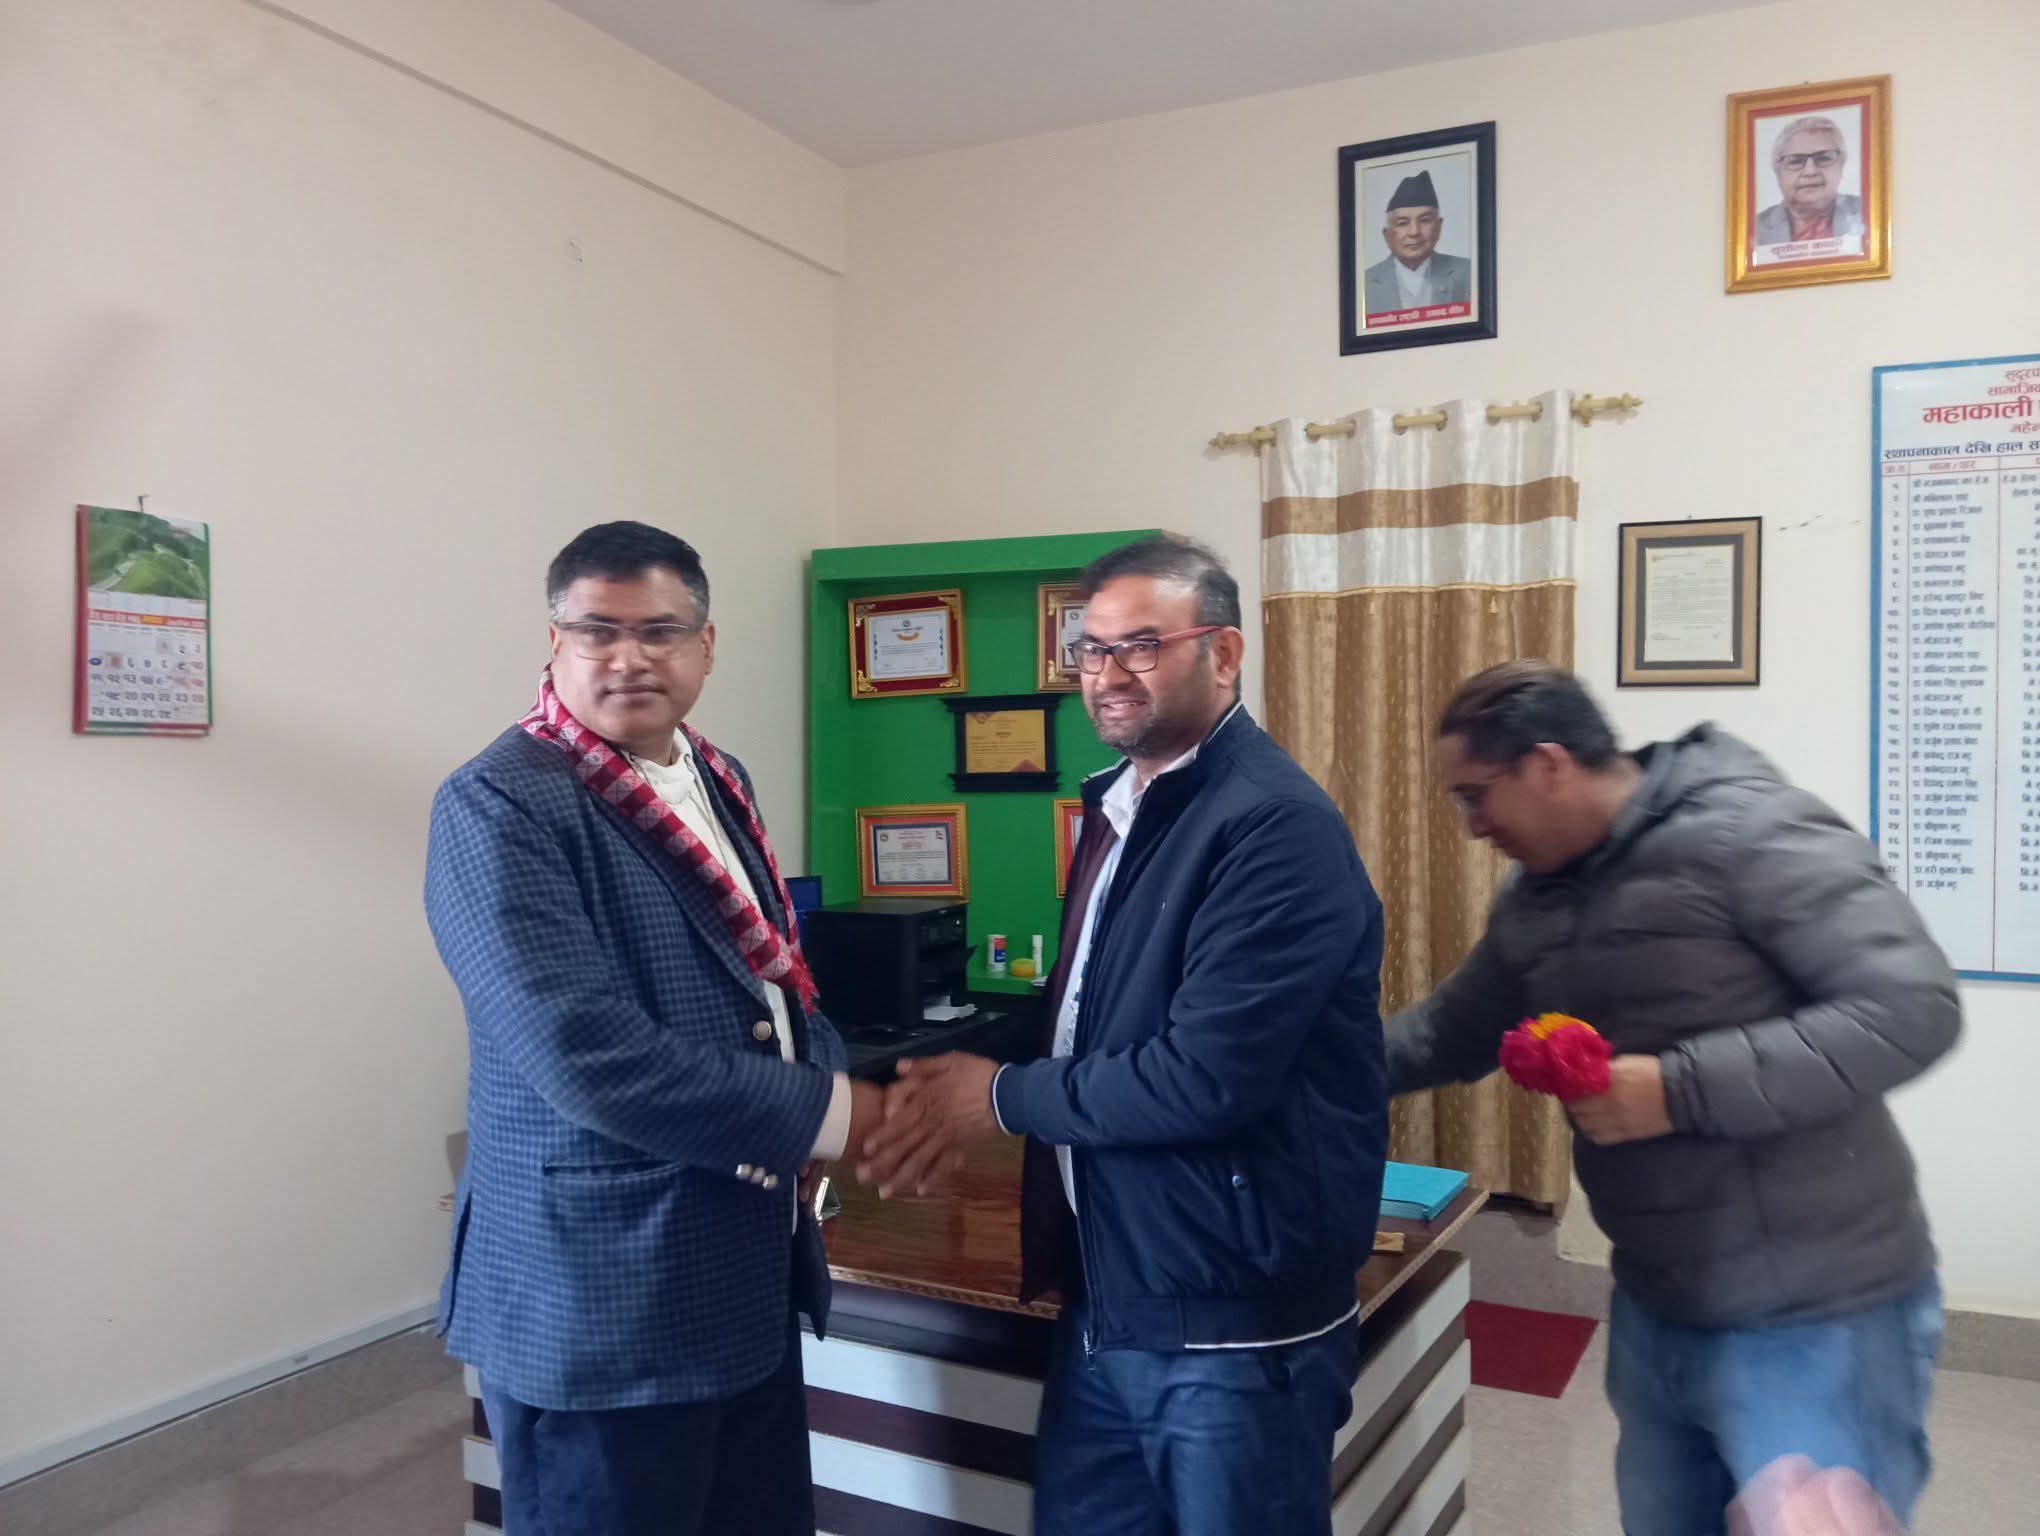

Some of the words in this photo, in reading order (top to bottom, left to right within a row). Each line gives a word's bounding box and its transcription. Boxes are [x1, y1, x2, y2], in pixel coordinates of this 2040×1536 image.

[1922, 395, 2033, 425] महाकाली
[1883, 445, 1961, 460] स्थापनाकाल
[1965, 440, 1992, 454] देखि
[1996, 441, 2023, 453] हाल
